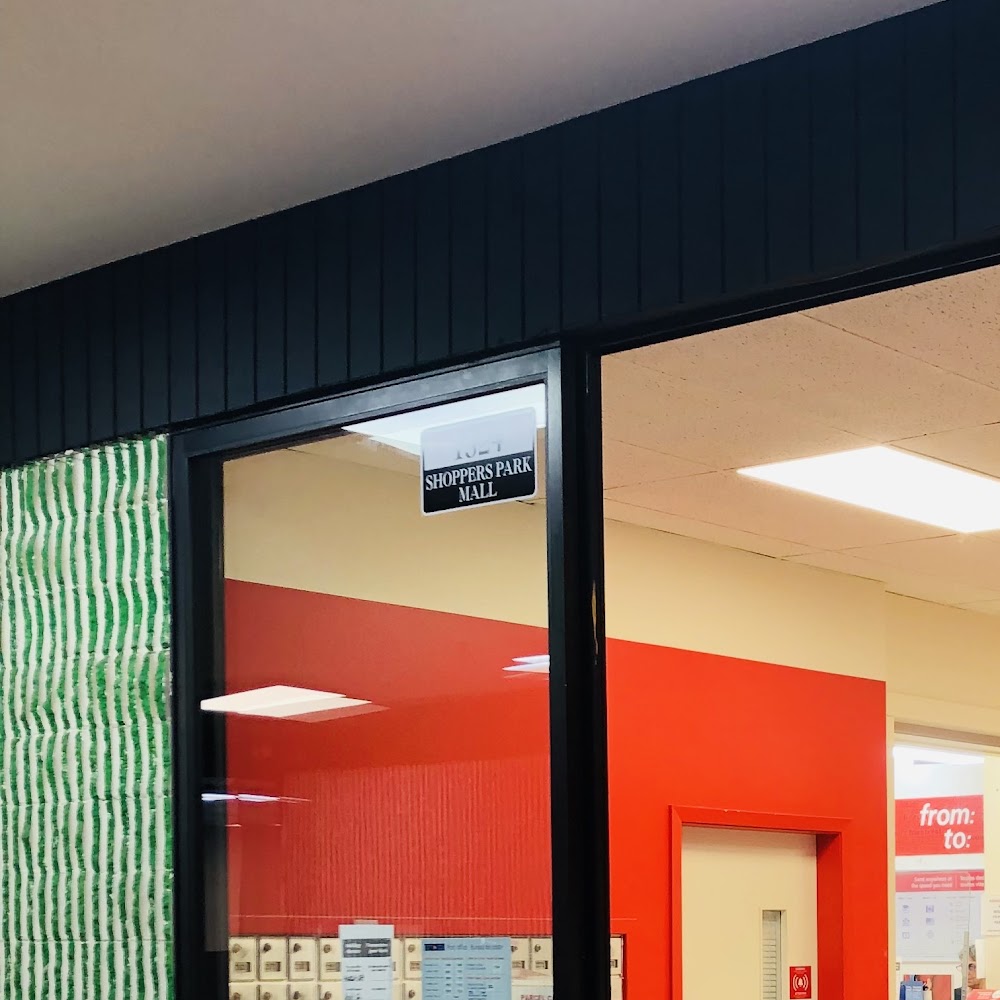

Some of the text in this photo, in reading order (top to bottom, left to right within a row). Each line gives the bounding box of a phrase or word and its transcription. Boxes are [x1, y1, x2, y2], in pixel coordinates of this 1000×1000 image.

[425, 456, 533, 491] SHOPPERS PARK
[458, 481, 498, 503] MALL
[919, 802, 975, 827] from:
[944, 828, 972, 849] to:
